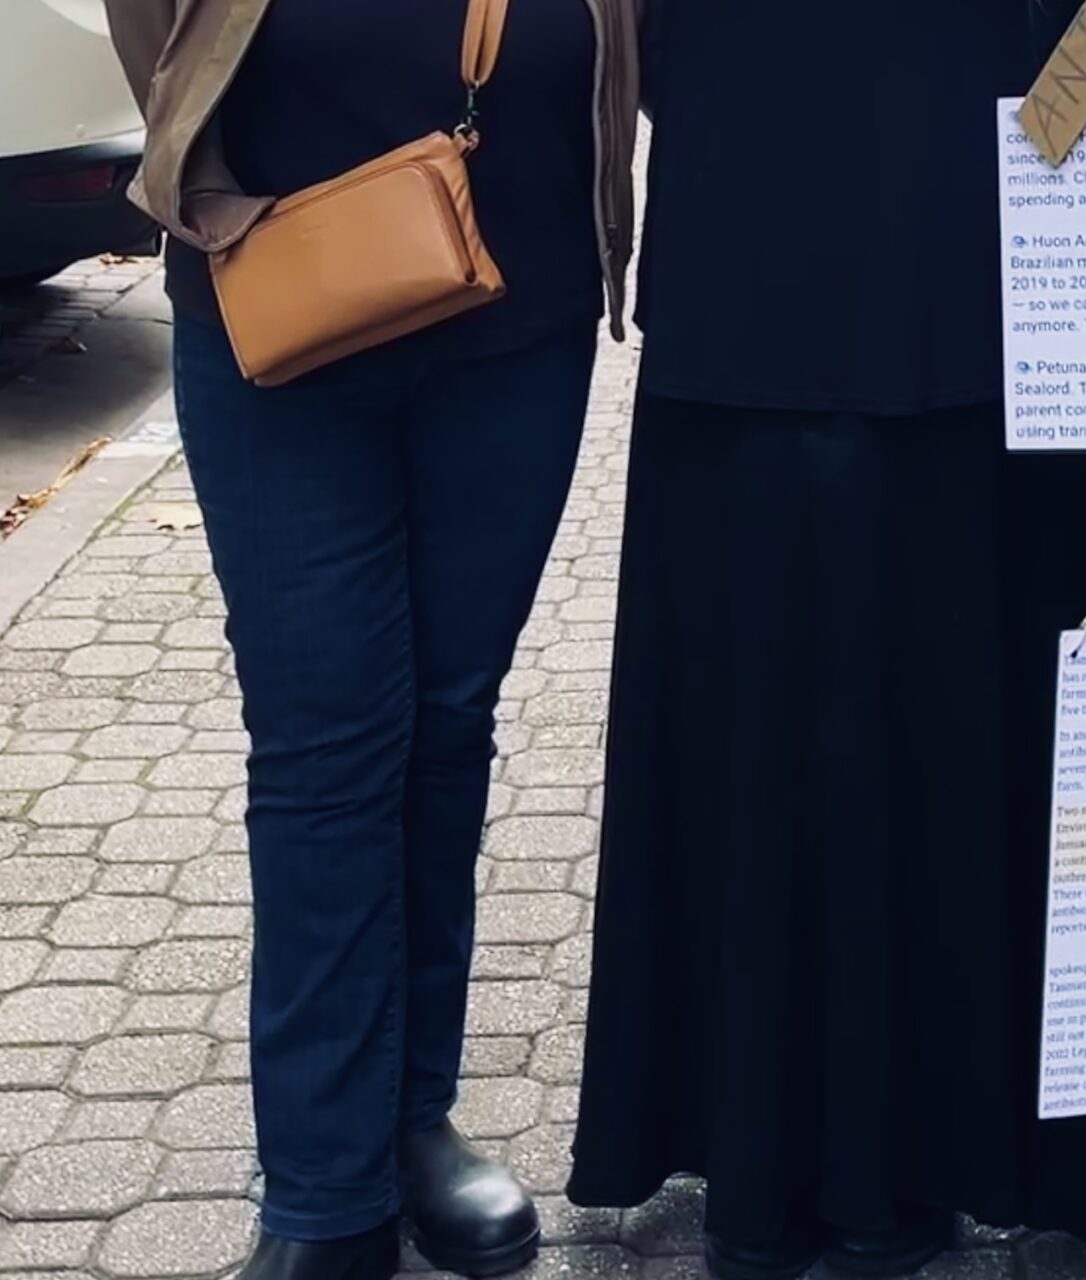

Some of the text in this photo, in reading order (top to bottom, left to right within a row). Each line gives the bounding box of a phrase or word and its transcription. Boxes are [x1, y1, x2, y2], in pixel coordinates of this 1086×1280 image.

[1007, 153, 1045, 164] since
[1007, 170, 1068, 184] millions.
[1008, 192, 1074, 209] spending
[1032, 235, 1070, 247] Huon
[1010, 255, 1073, 268] Brazilian
[1011, 276, 1047, 289] 2019
[1051, 277, 1065, 288] to
[1029, 300, 1045, 310] so
[1049, 300, 1069, 310] we
[1013, 321, 1080, 334] anymore.
[1036, 360, 1086, 373] Petuna
[1015, 381, 1075, 394] Sealord.
[1015, 404, 1061, 418] parent
[1016, 425, 1055, 440] using
